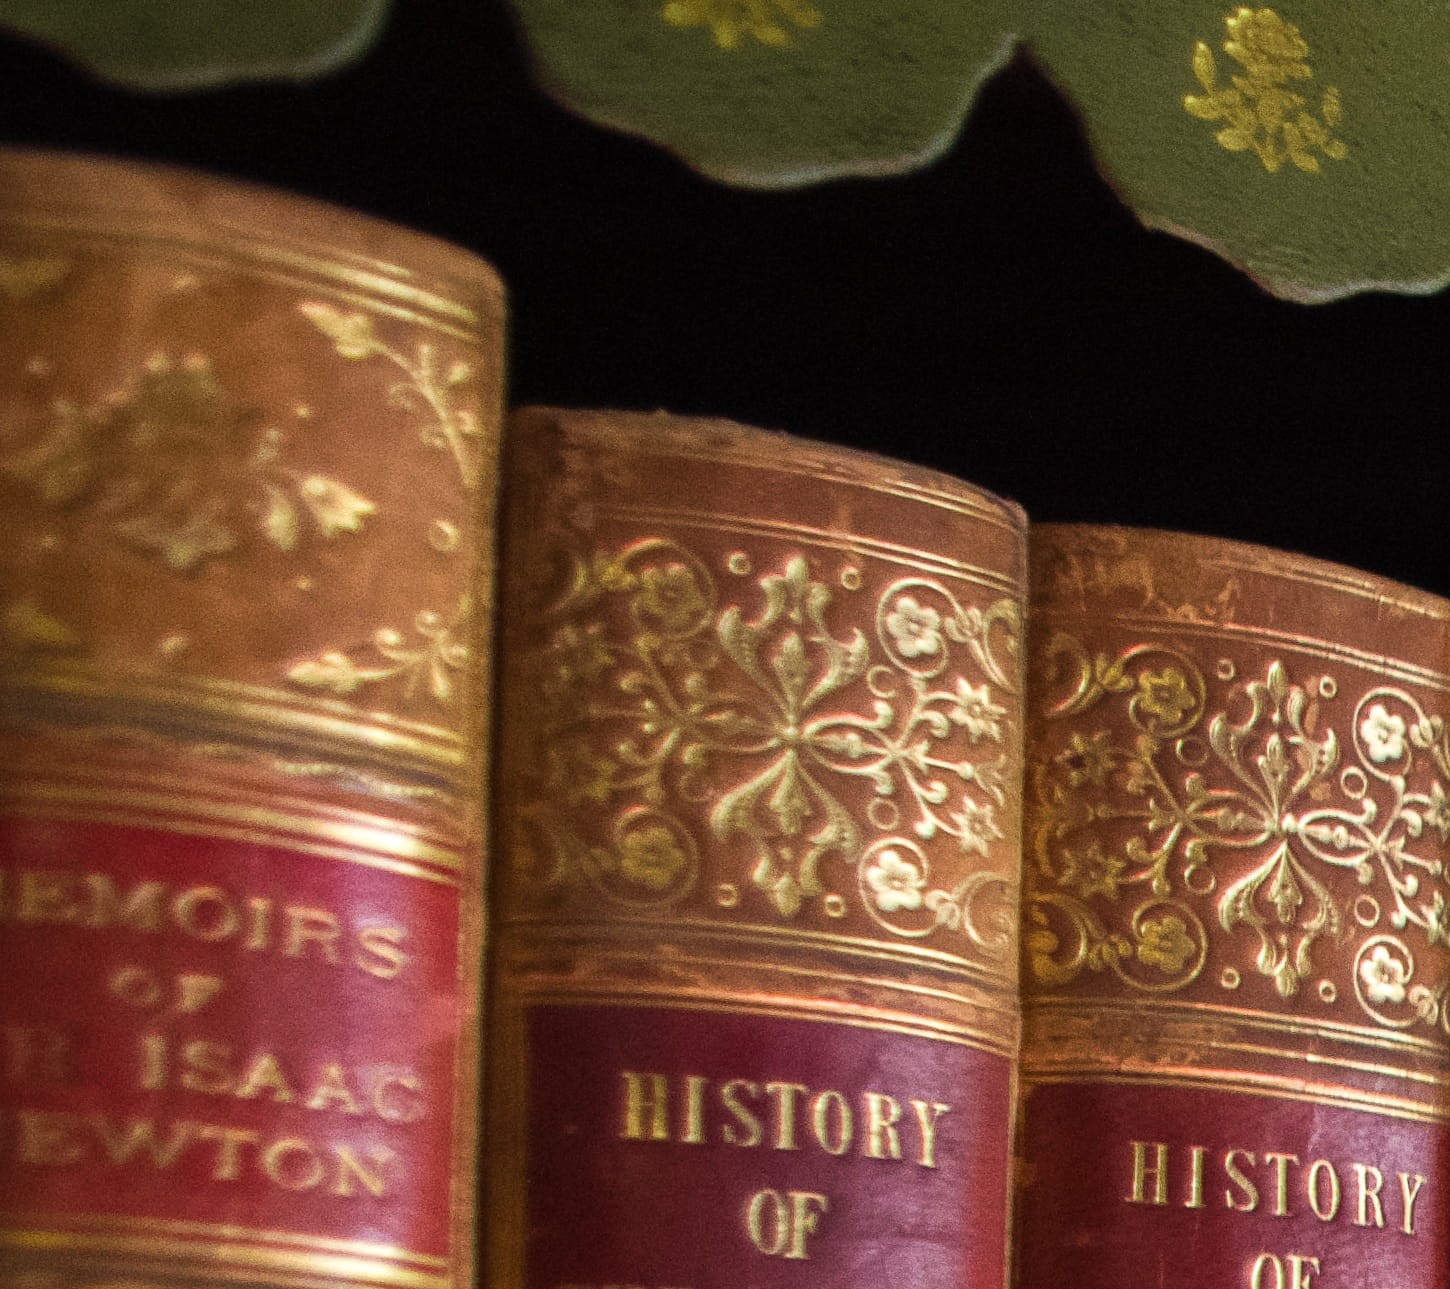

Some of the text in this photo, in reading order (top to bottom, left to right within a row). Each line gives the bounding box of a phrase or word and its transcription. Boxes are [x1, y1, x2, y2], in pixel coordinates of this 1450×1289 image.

[0, 866, 410, 979] EMOIRS
[16, 1111, 398, 1197] EWTON
[620, 1070, 951, 1168] HISTORY
[746, 1188, 829, 1259] OF
[1125, 1141, 1428, 1235] HISTORY
